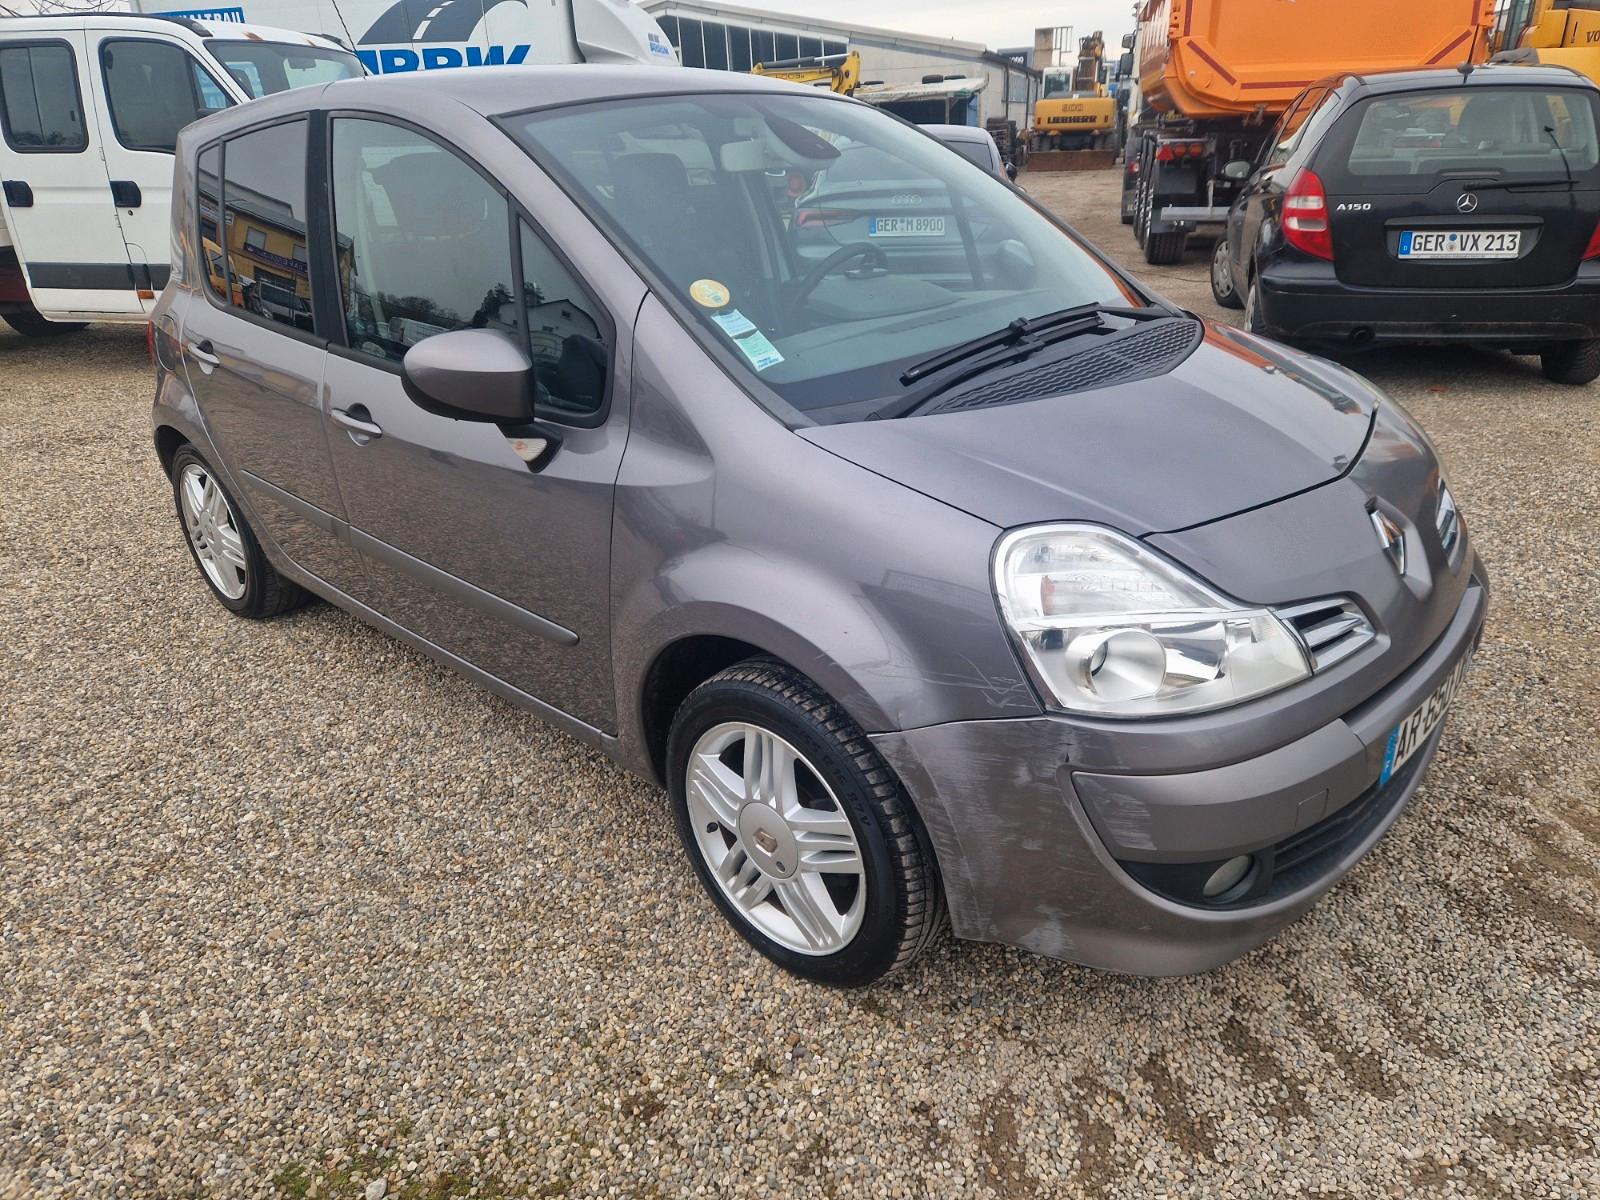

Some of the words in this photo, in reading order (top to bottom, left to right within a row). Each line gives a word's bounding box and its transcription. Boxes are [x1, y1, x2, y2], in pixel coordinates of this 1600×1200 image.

[1047, 115, 1097, 124] LIEBHERR
[1336, 203, 1372, 211] A150
[877, 218, 898, 232] GER
[916, 218, 943, 232] 8900
[1413, 234, 1446, 252] GER
[1460, 234, 1481, 252] VX
[1484, 234, 1518, 252] 213
